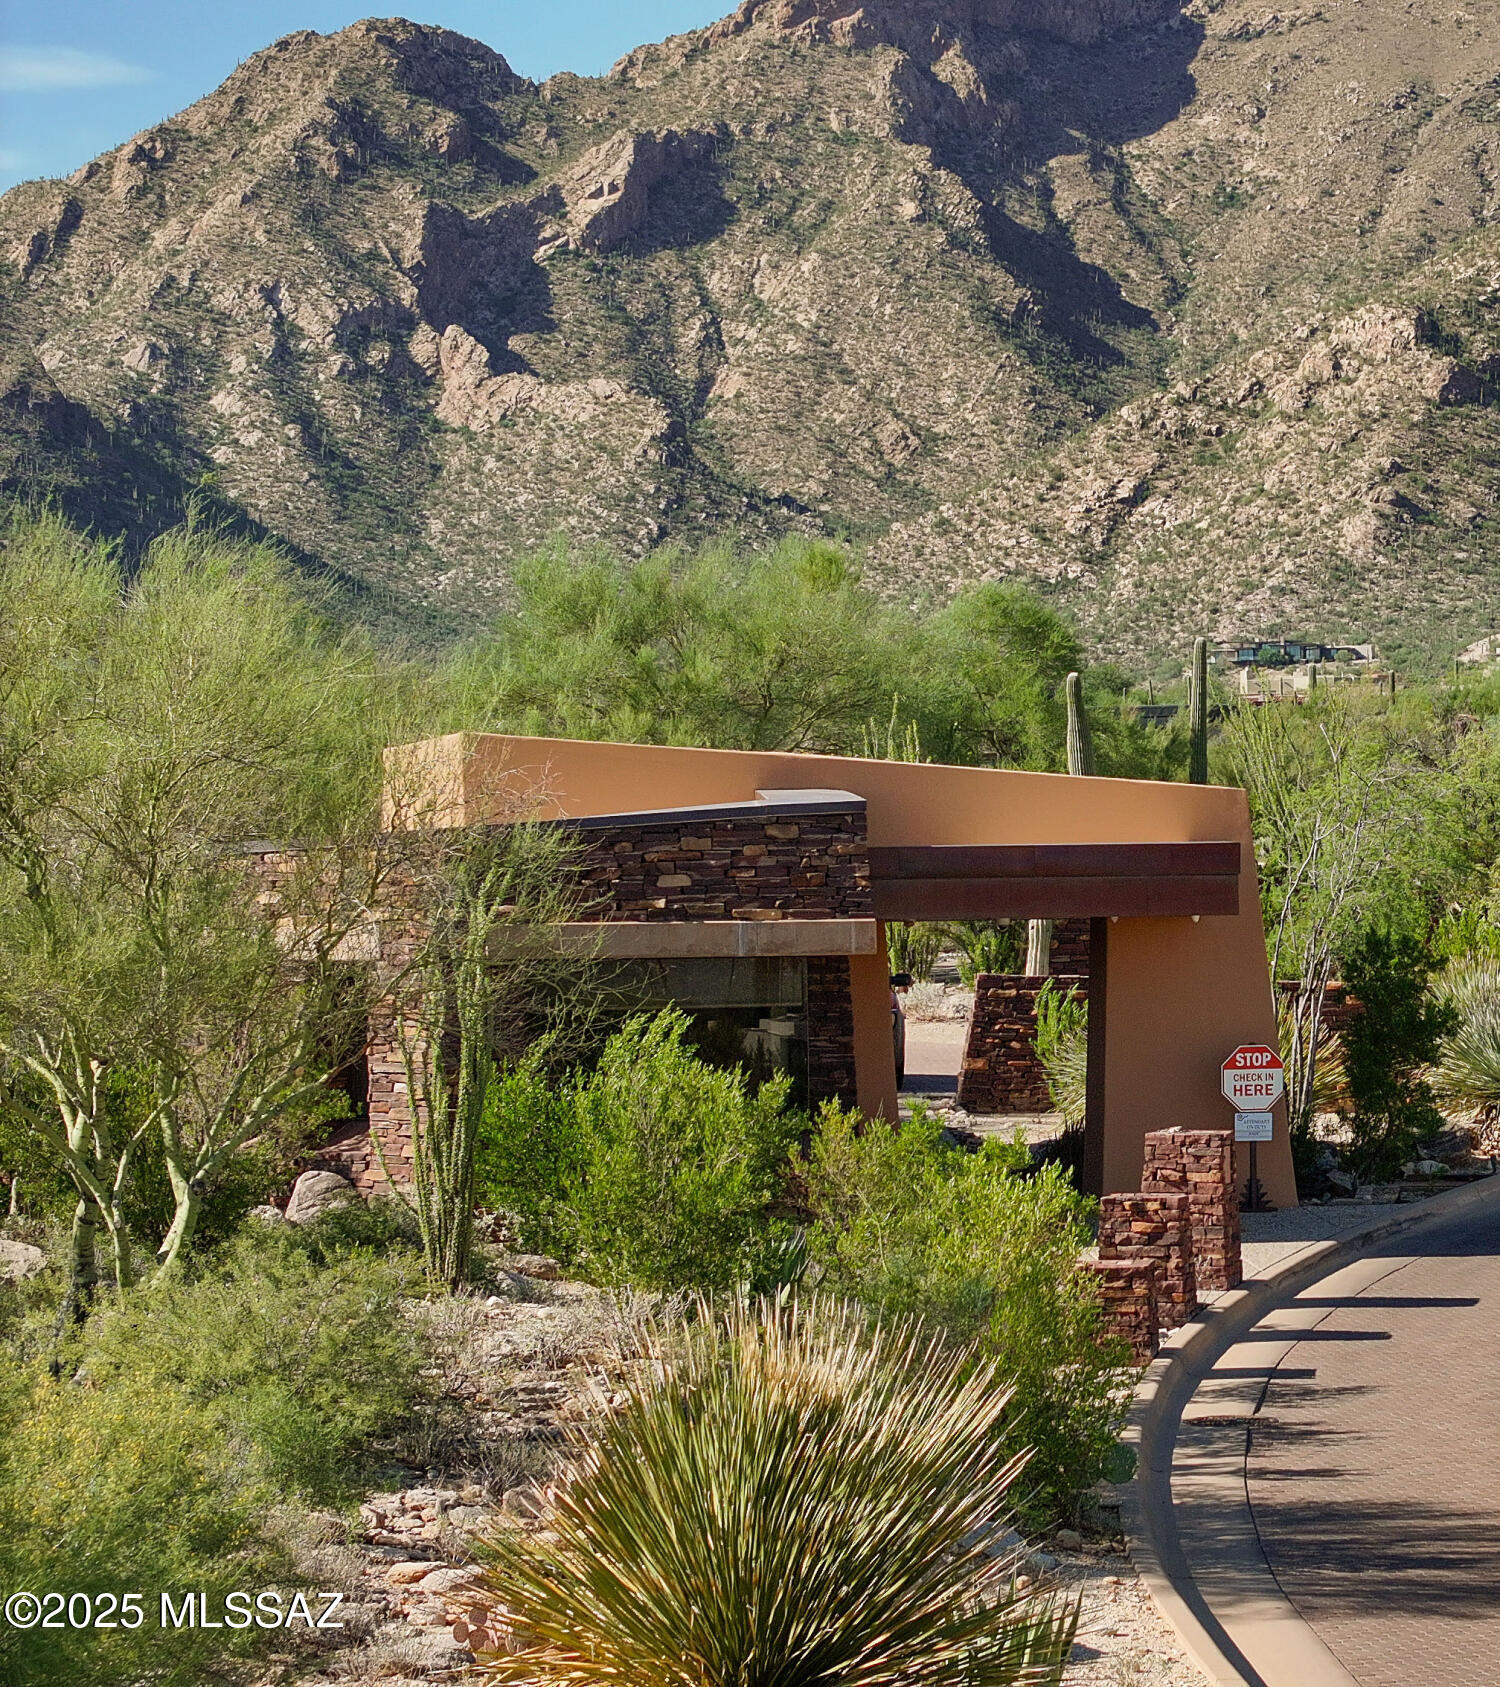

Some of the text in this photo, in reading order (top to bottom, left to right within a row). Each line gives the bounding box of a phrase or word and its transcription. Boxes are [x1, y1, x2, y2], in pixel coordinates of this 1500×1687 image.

[1235, 1052, 1272, 1067] STOP
[1233, 1073, 1274, 1082] CHECK IN
[1233, 1084, 1274, 1097] HERE
